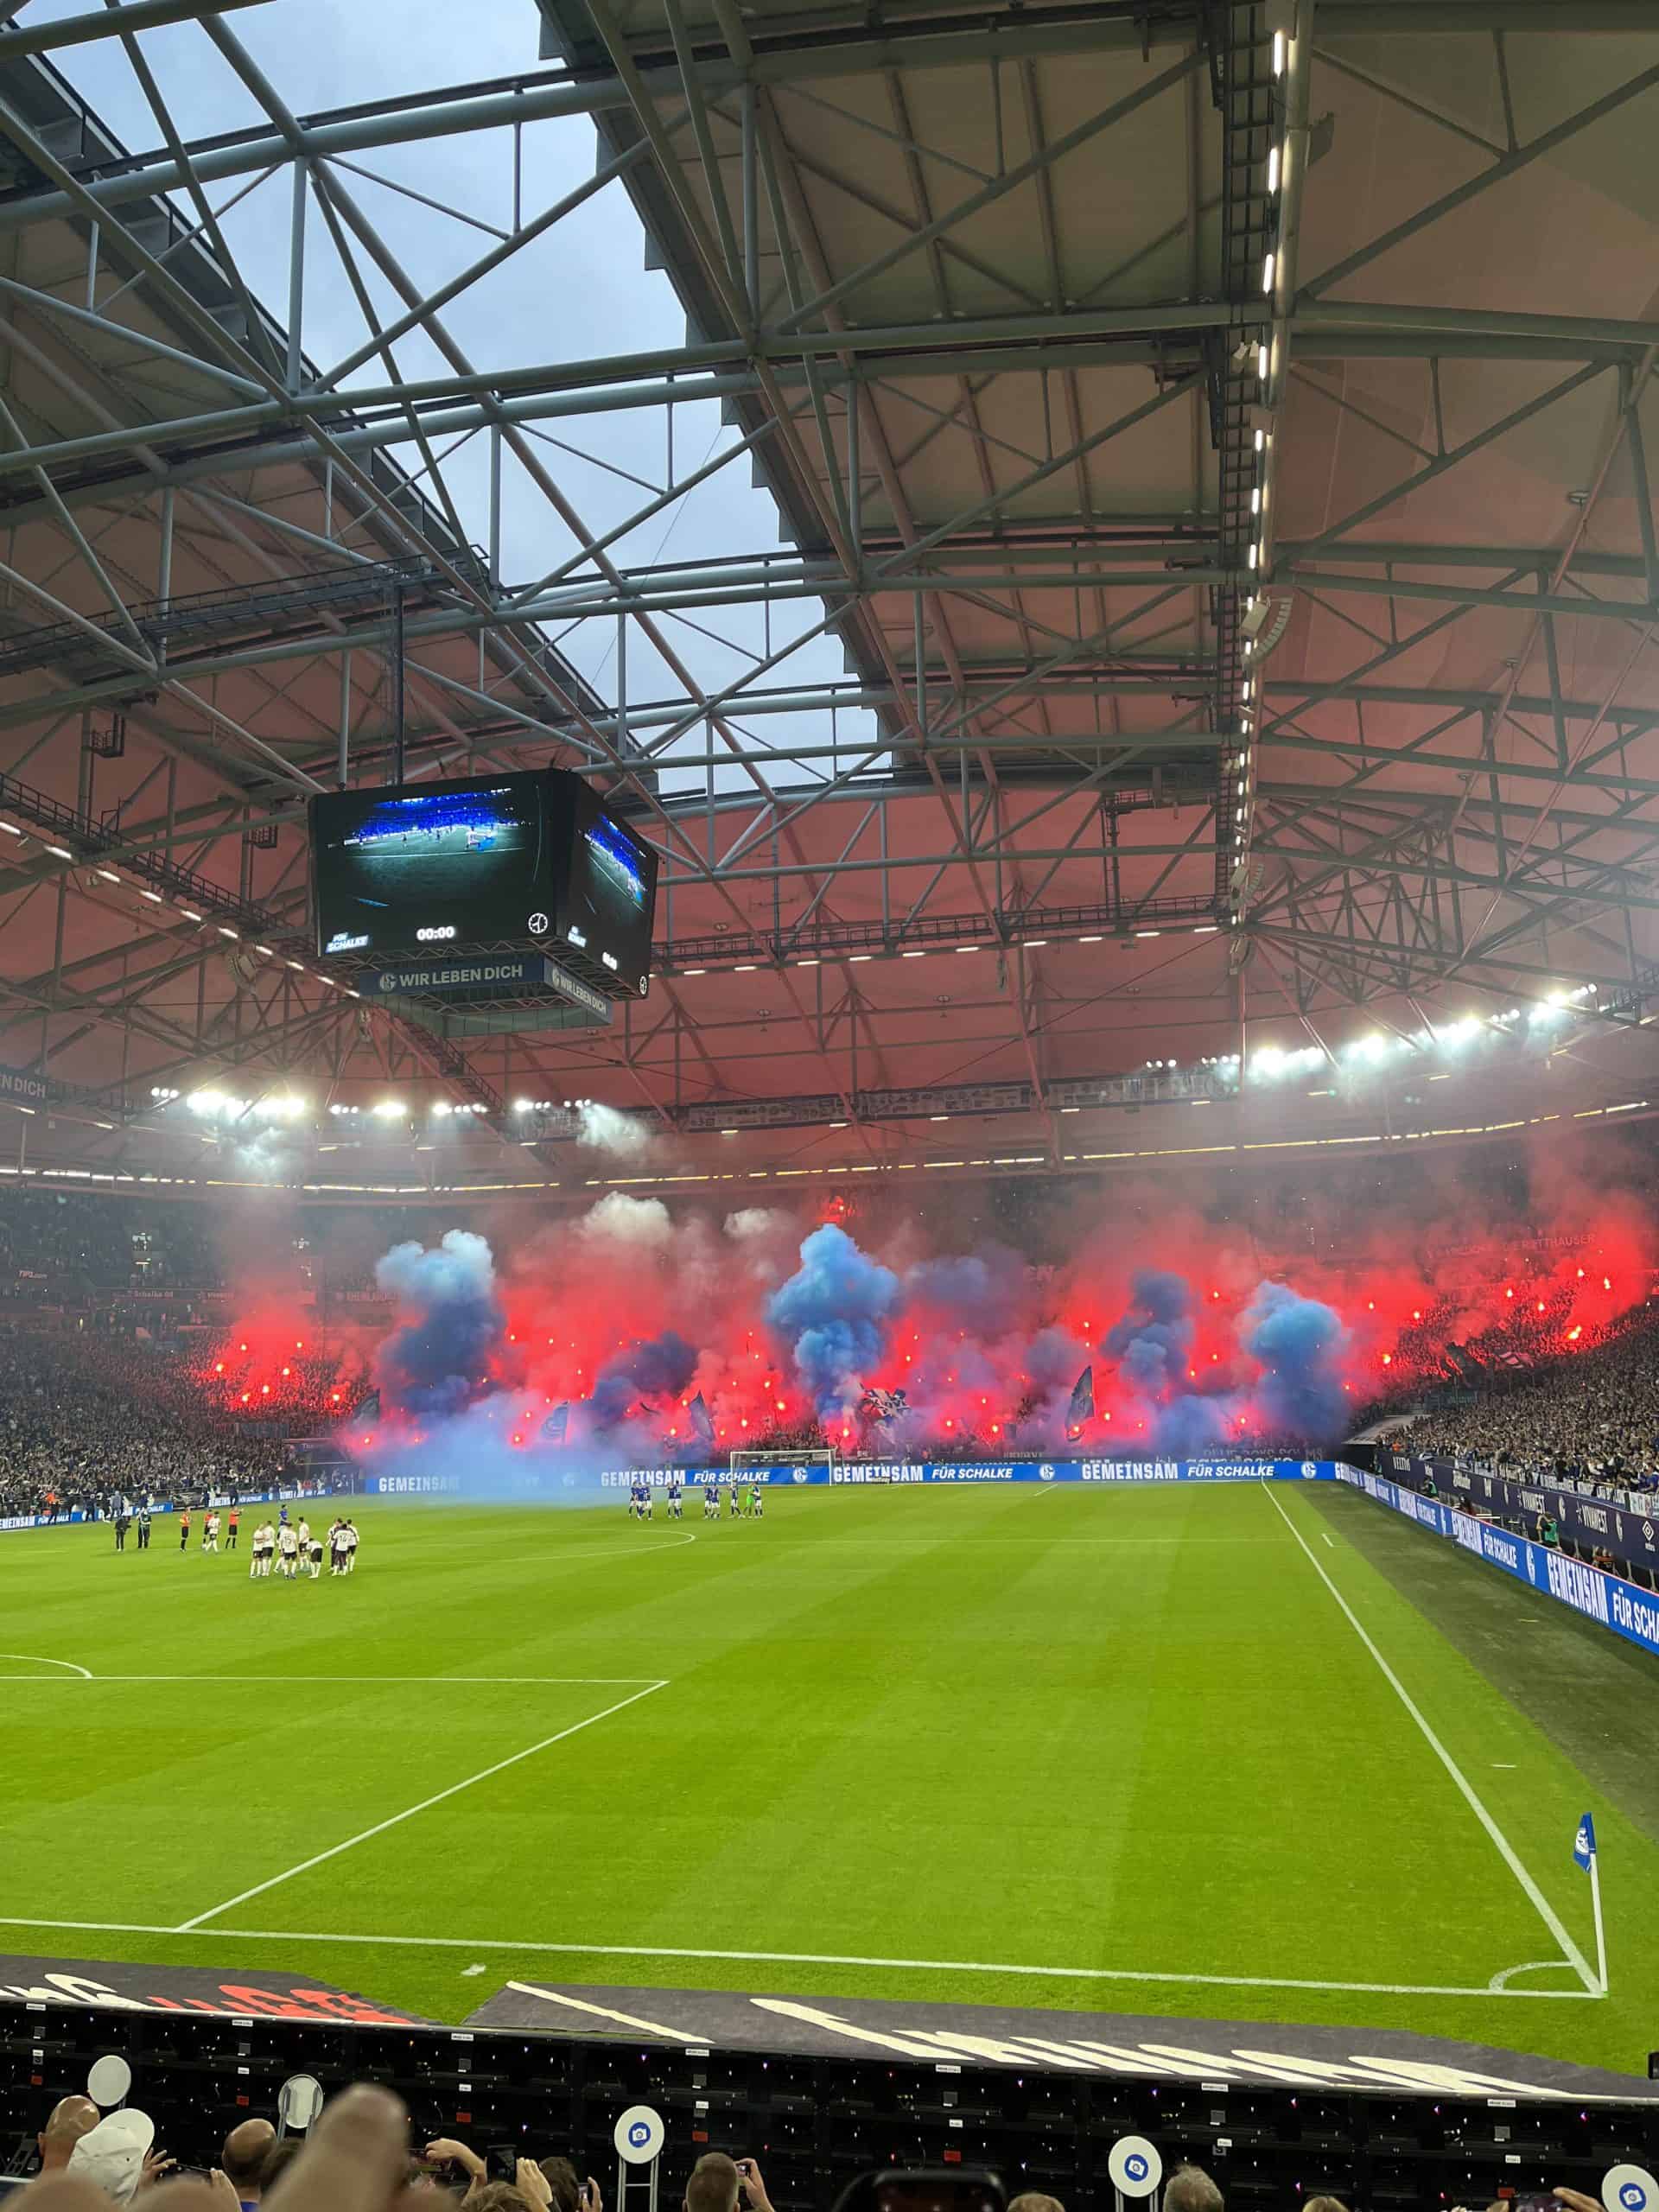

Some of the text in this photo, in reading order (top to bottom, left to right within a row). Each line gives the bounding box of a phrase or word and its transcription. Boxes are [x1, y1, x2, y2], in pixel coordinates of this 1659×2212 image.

[416, 926, 455, 941] 00:00
[399, 964, 523, 987] WIR LEBEN DICH
[560, 974, 607, 1014] WIR LEBEN DICH
[15, 1078, 46, 1098] DICH
[601, 1470, 770, 1486] GEMEINSAM FÜR SCHALKE
[833, 1465, 1013, 1483] GEMEINSAM FÜR SCHALKE
[1082, 1462, 1274, 1480] GEMEINSAM FÜR SCHALKE
[1494, 1537, 1517, 1569] SCHALKE
[1547, 1553, 1609, 1624] GEMEINSAM
[1612, 1586, 1633, 1630] FÜR
